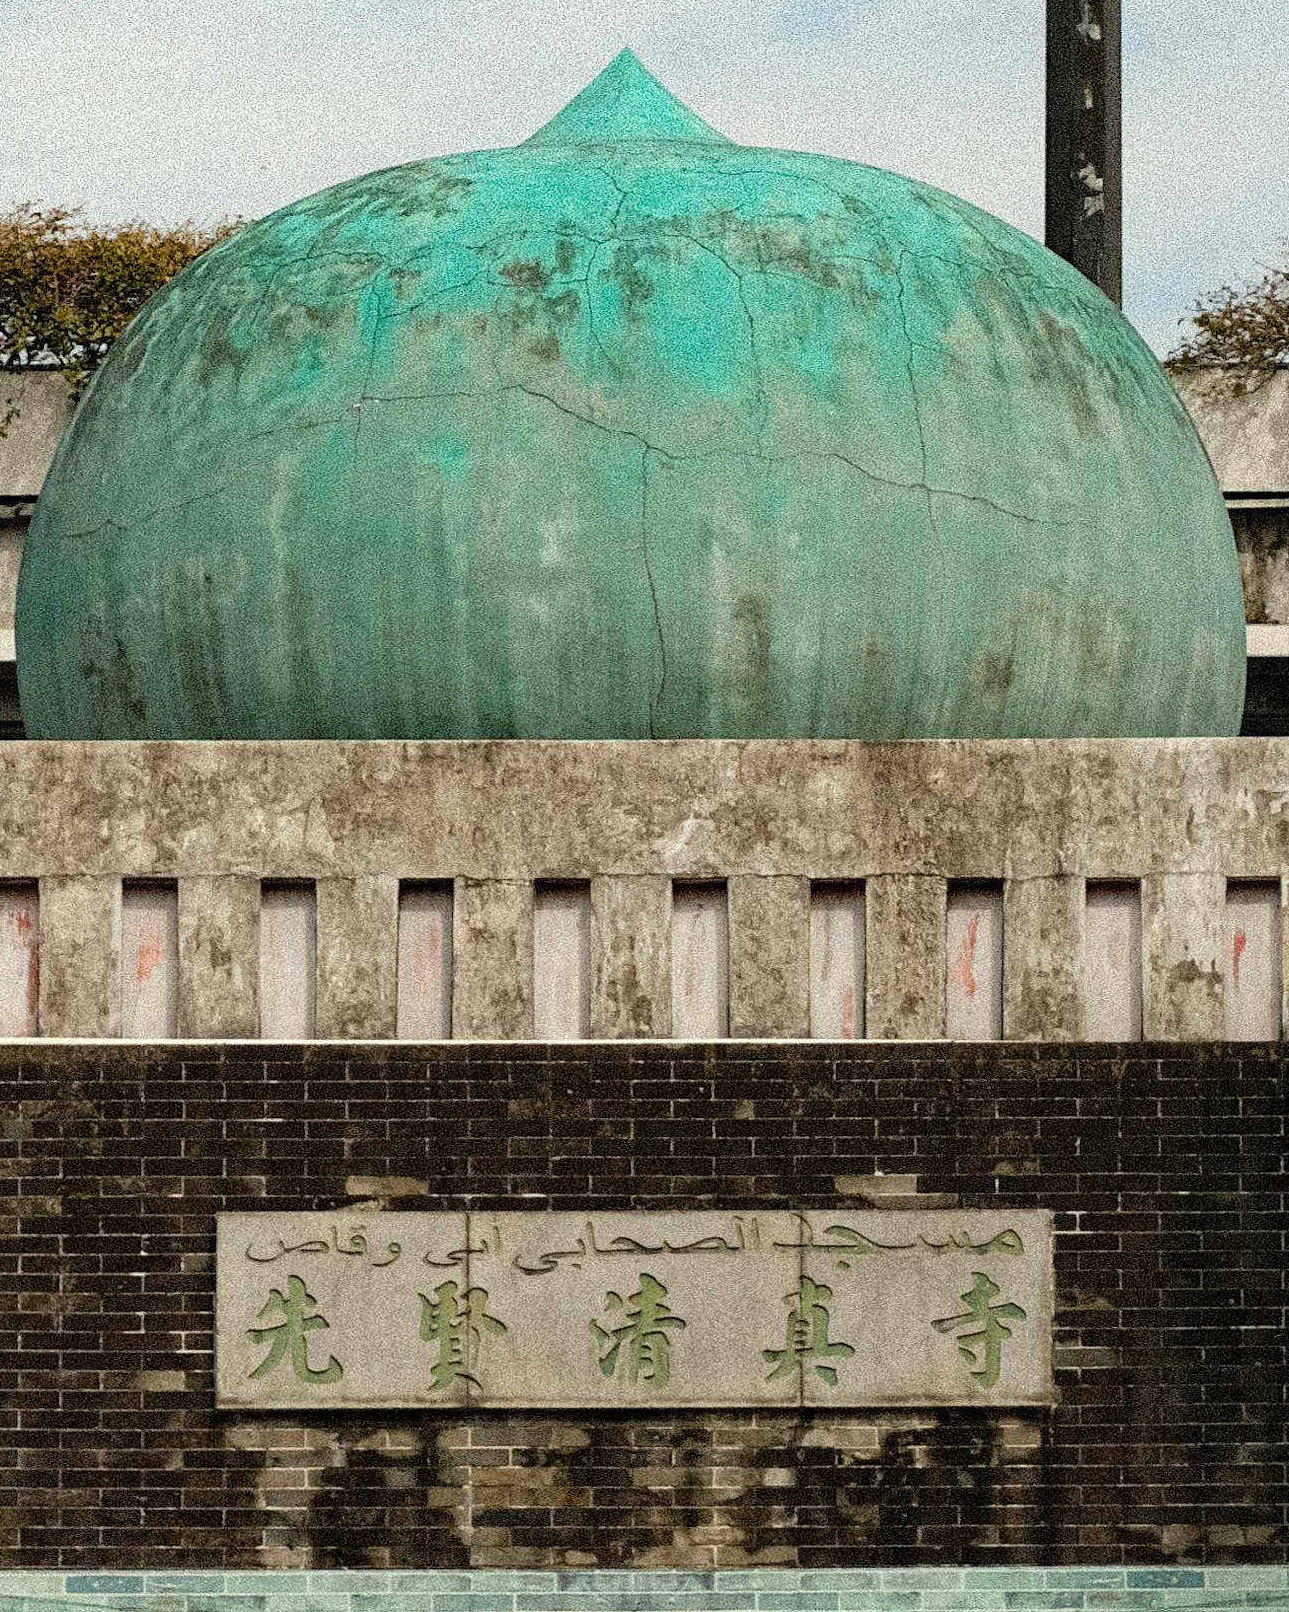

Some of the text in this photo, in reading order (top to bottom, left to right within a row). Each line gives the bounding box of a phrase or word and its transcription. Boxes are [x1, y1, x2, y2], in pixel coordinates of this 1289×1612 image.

[244, 1271, 1028, 1391] 先賢清真寺
